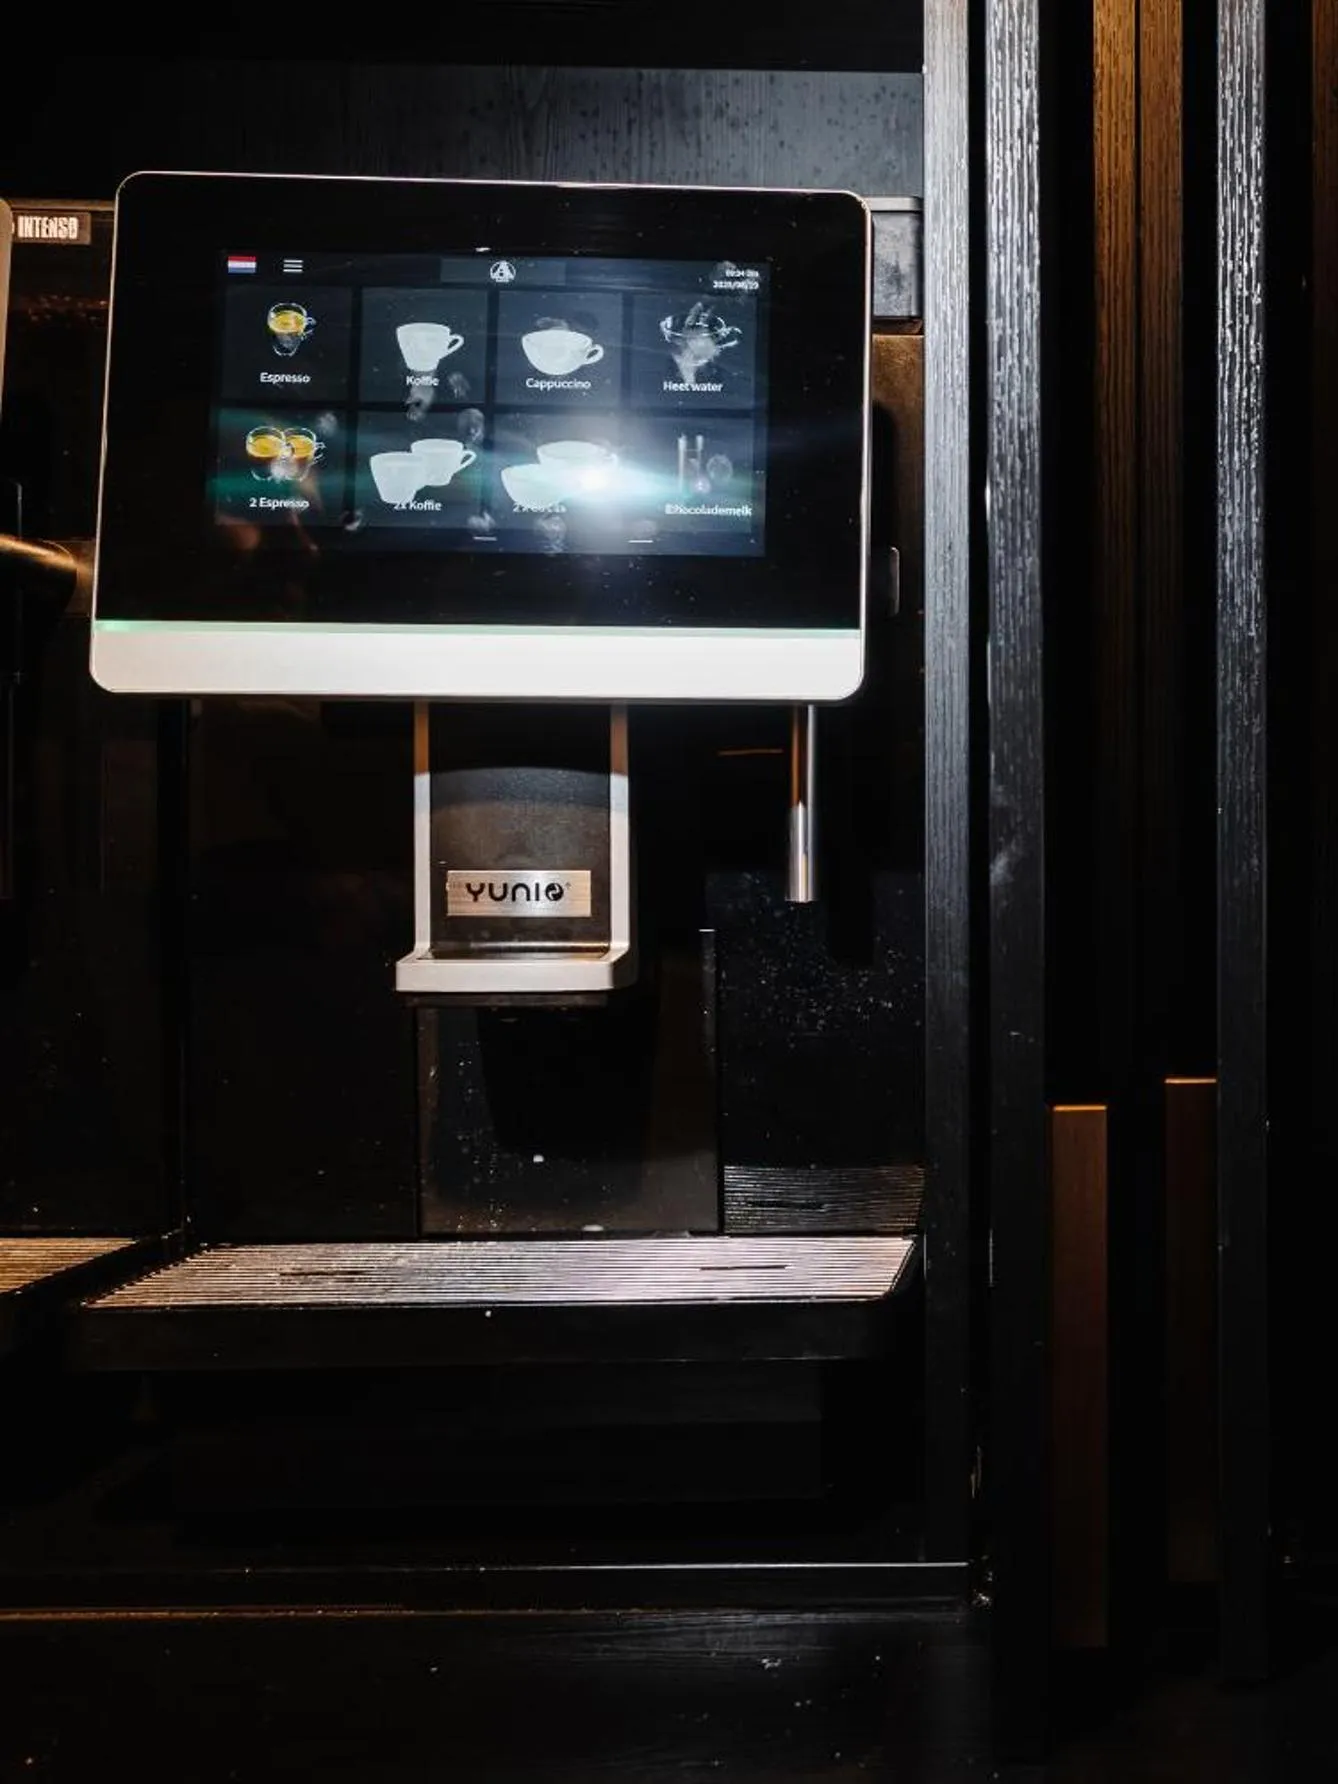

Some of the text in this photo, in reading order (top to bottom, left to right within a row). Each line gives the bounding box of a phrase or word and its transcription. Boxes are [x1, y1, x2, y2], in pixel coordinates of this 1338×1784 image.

[17, 216, 79, 239] INTENSO
[260, 372, 310, 385] Espresso
[525, 377, 591, 390] Cappuccino
[691, 383, 723, 392] water
[250, 497, 310, 510] 2 Espresso
[409, 500, 442, 510] Koffie
